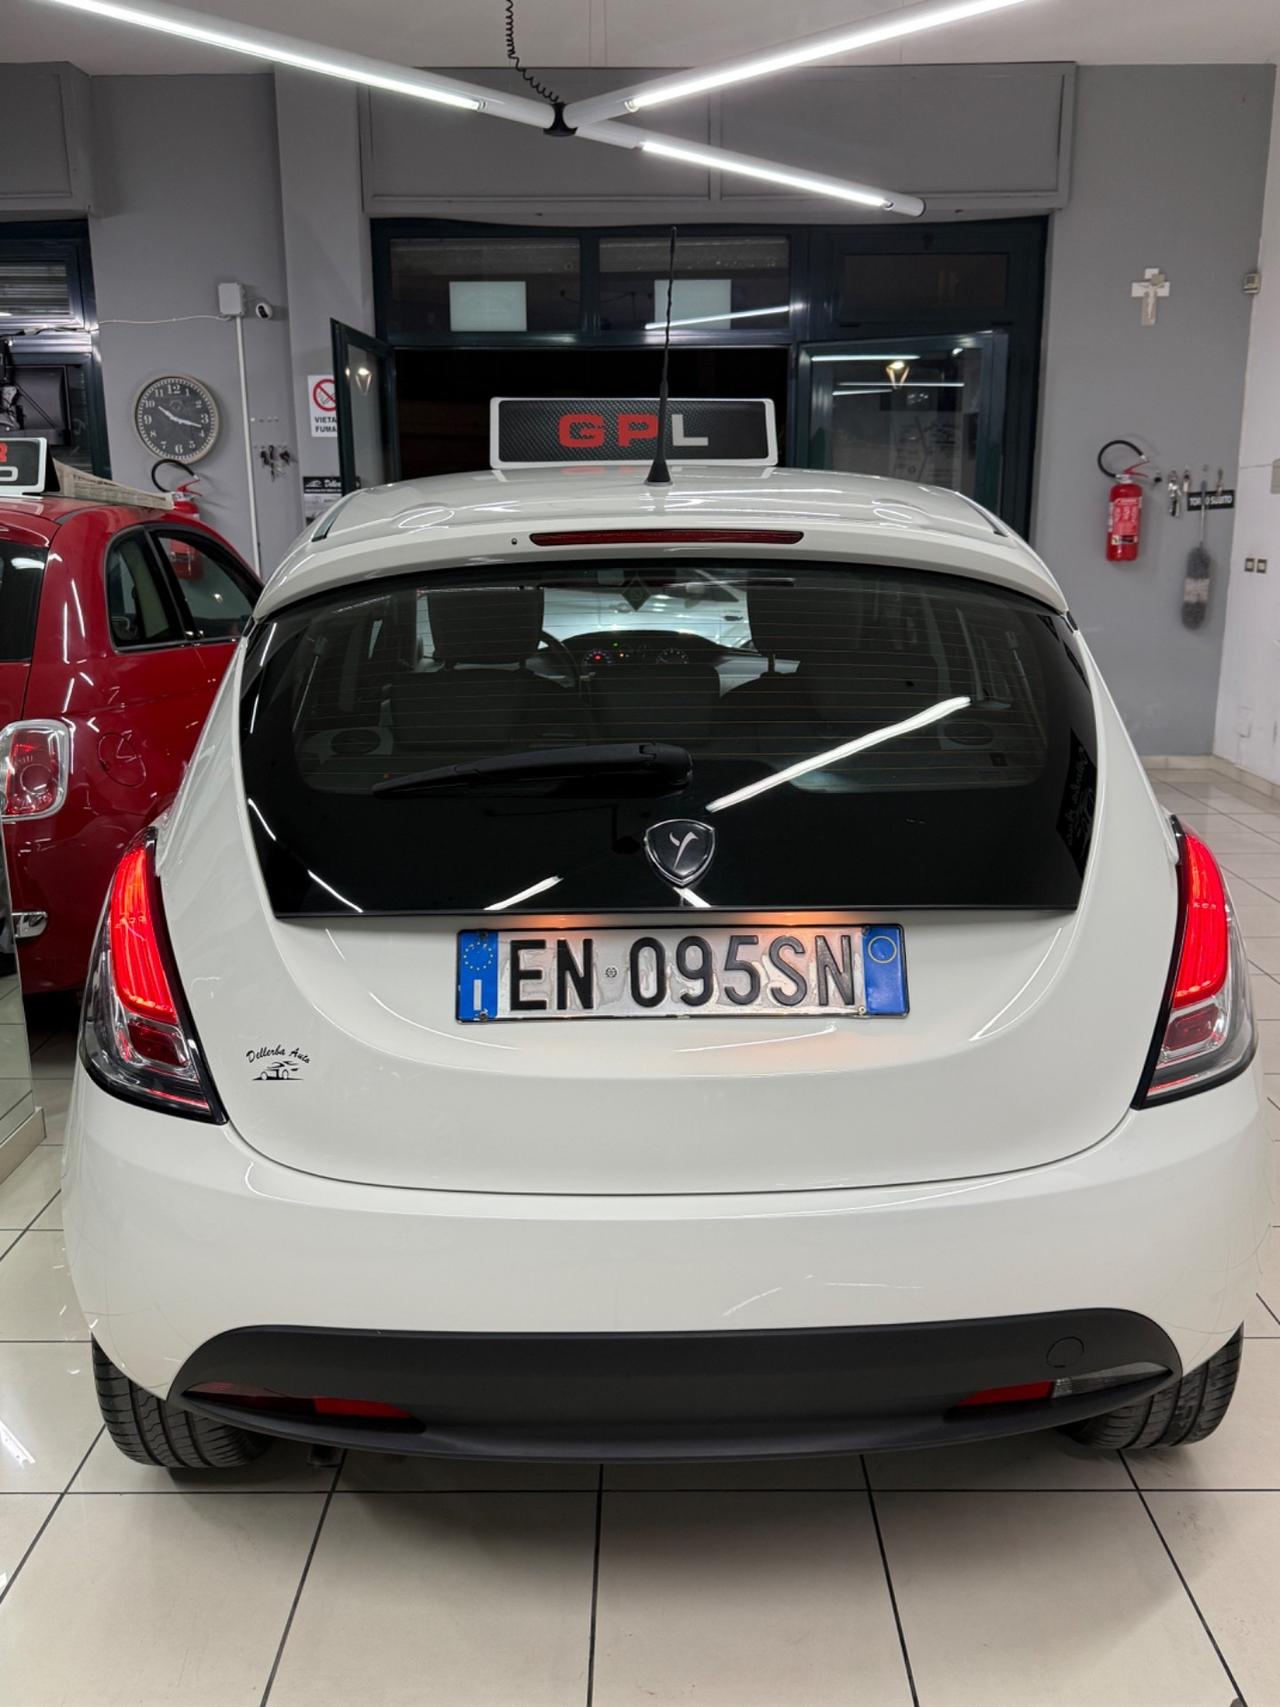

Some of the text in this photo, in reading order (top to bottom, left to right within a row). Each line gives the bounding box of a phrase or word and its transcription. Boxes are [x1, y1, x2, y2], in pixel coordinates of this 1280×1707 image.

[155, 388, 164, 397] 11
[167, 384, 181, 394] 12
[185, 388, 190, 397] 1
[145, 400, 155, 408] 10
[143, 414, 152, 425] 9
[200, 413, 209, 424] 3
[149, 429, 157, 438] 8
[198, 429, 205, 438] 4
[558, 413, 709, 448] GPL
[160, 440, 167, 449] 7
[174, 443, 183, 454] 6
[189, 440, 196, 449] 5
[1189, 496, 1210, 506] TORO
[510, 934, 857, 1011] EN 095SN
[246, 1044, 311, 1064] Dellerba Auto
